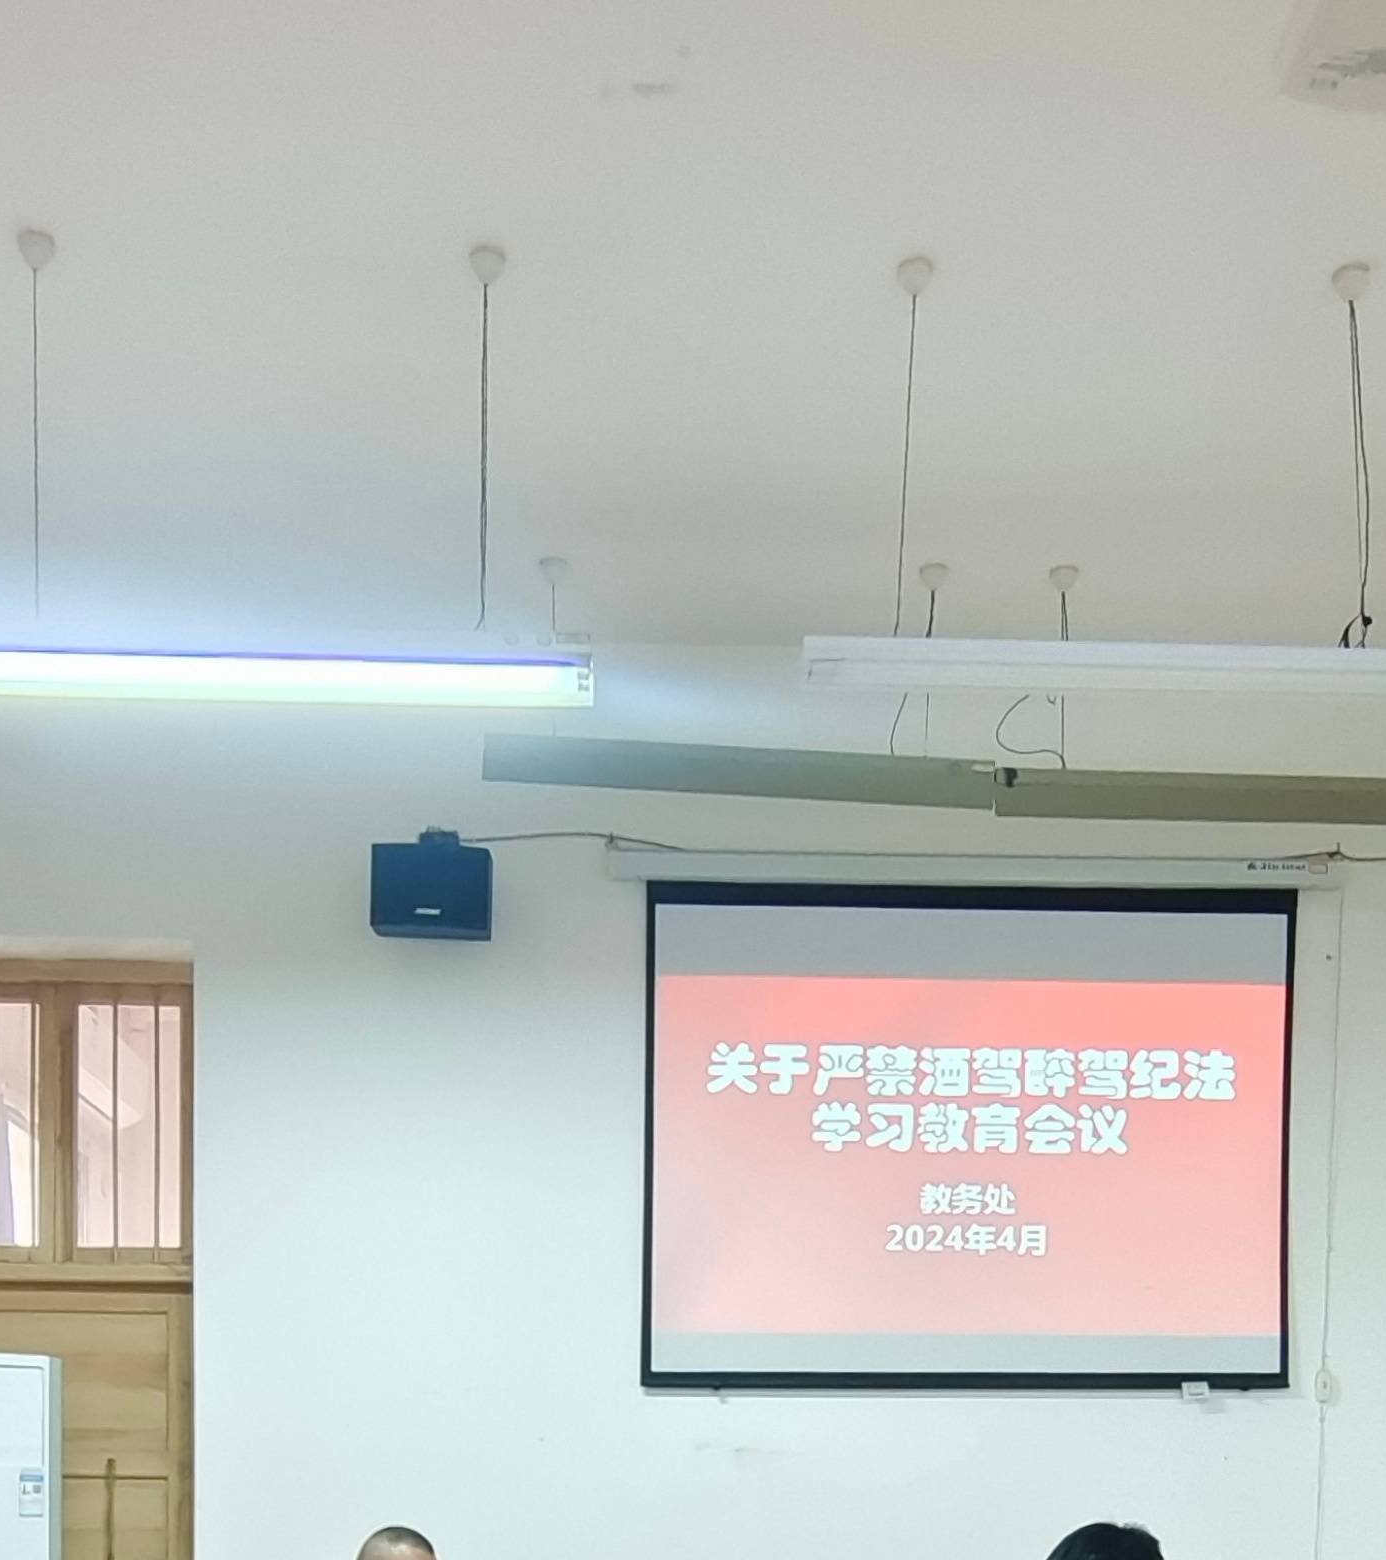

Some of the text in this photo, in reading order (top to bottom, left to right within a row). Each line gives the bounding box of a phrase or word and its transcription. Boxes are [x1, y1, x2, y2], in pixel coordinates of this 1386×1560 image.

[706, 1043, 1237, 1101] 关于严禁酒驾醉驾纪法
[812, 1102, 1129, 1155] 学习教育会议
[919, 1183, 1017, 1216] 教务处
[885, 1225, 1048, 1257] 2024年4月
